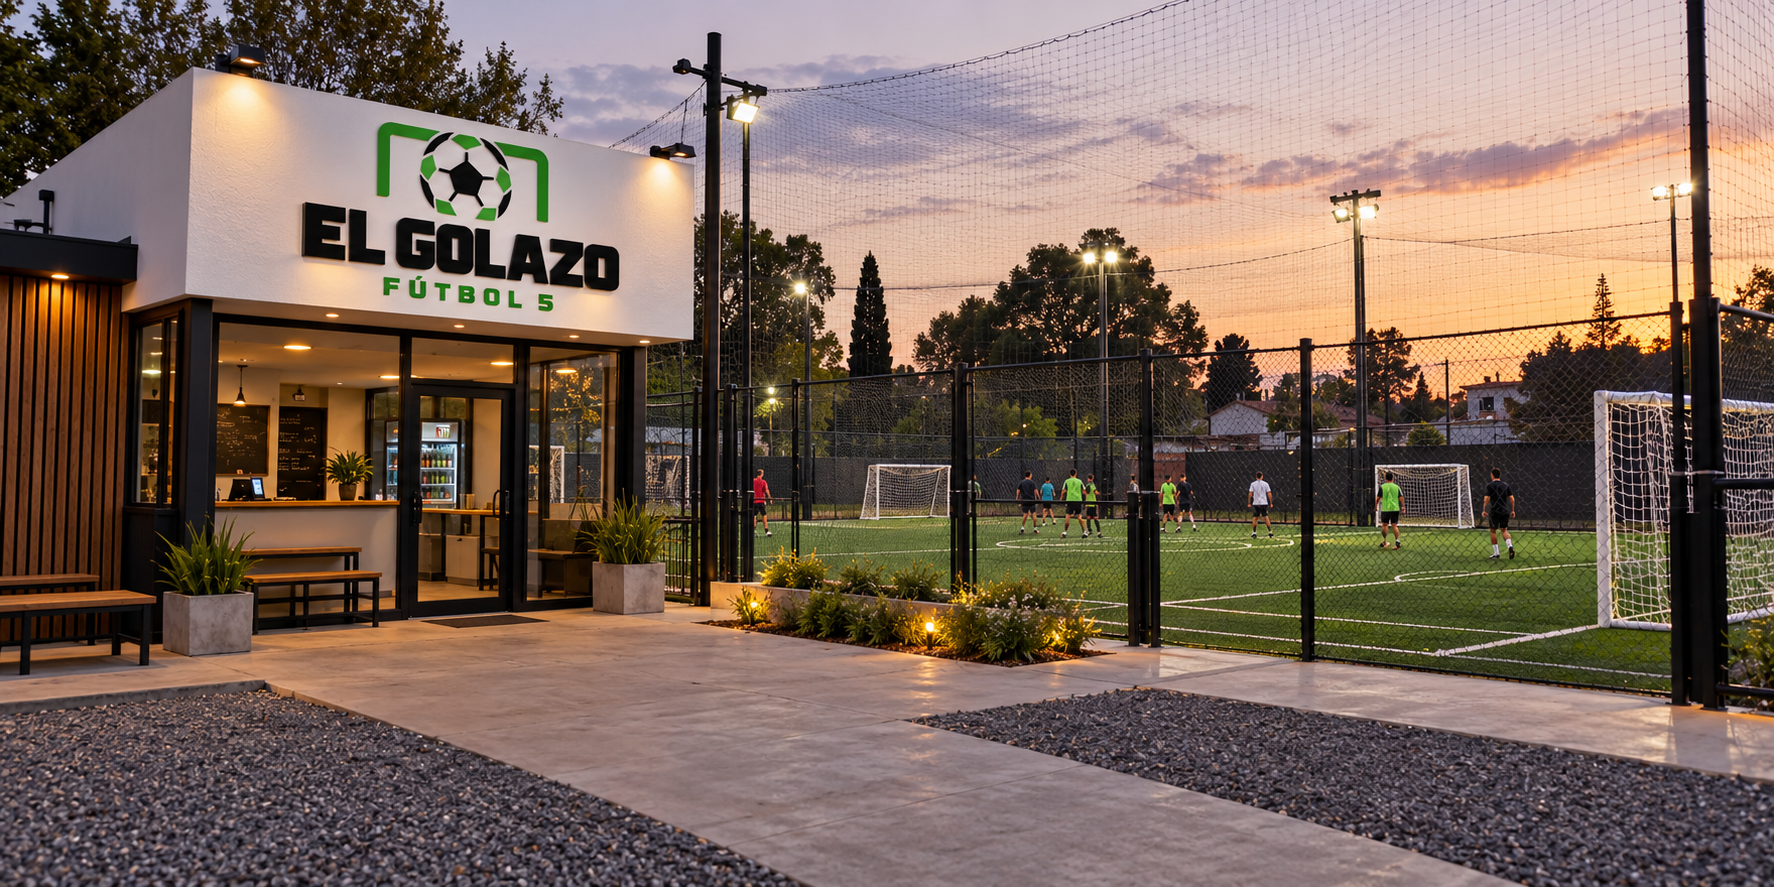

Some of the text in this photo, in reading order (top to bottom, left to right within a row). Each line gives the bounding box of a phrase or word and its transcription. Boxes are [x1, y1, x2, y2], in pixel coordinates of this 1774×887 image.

[301, 202, 619, 291] EL GOLAZO
[383, 276, 554, 312] FÚTBOL 5
